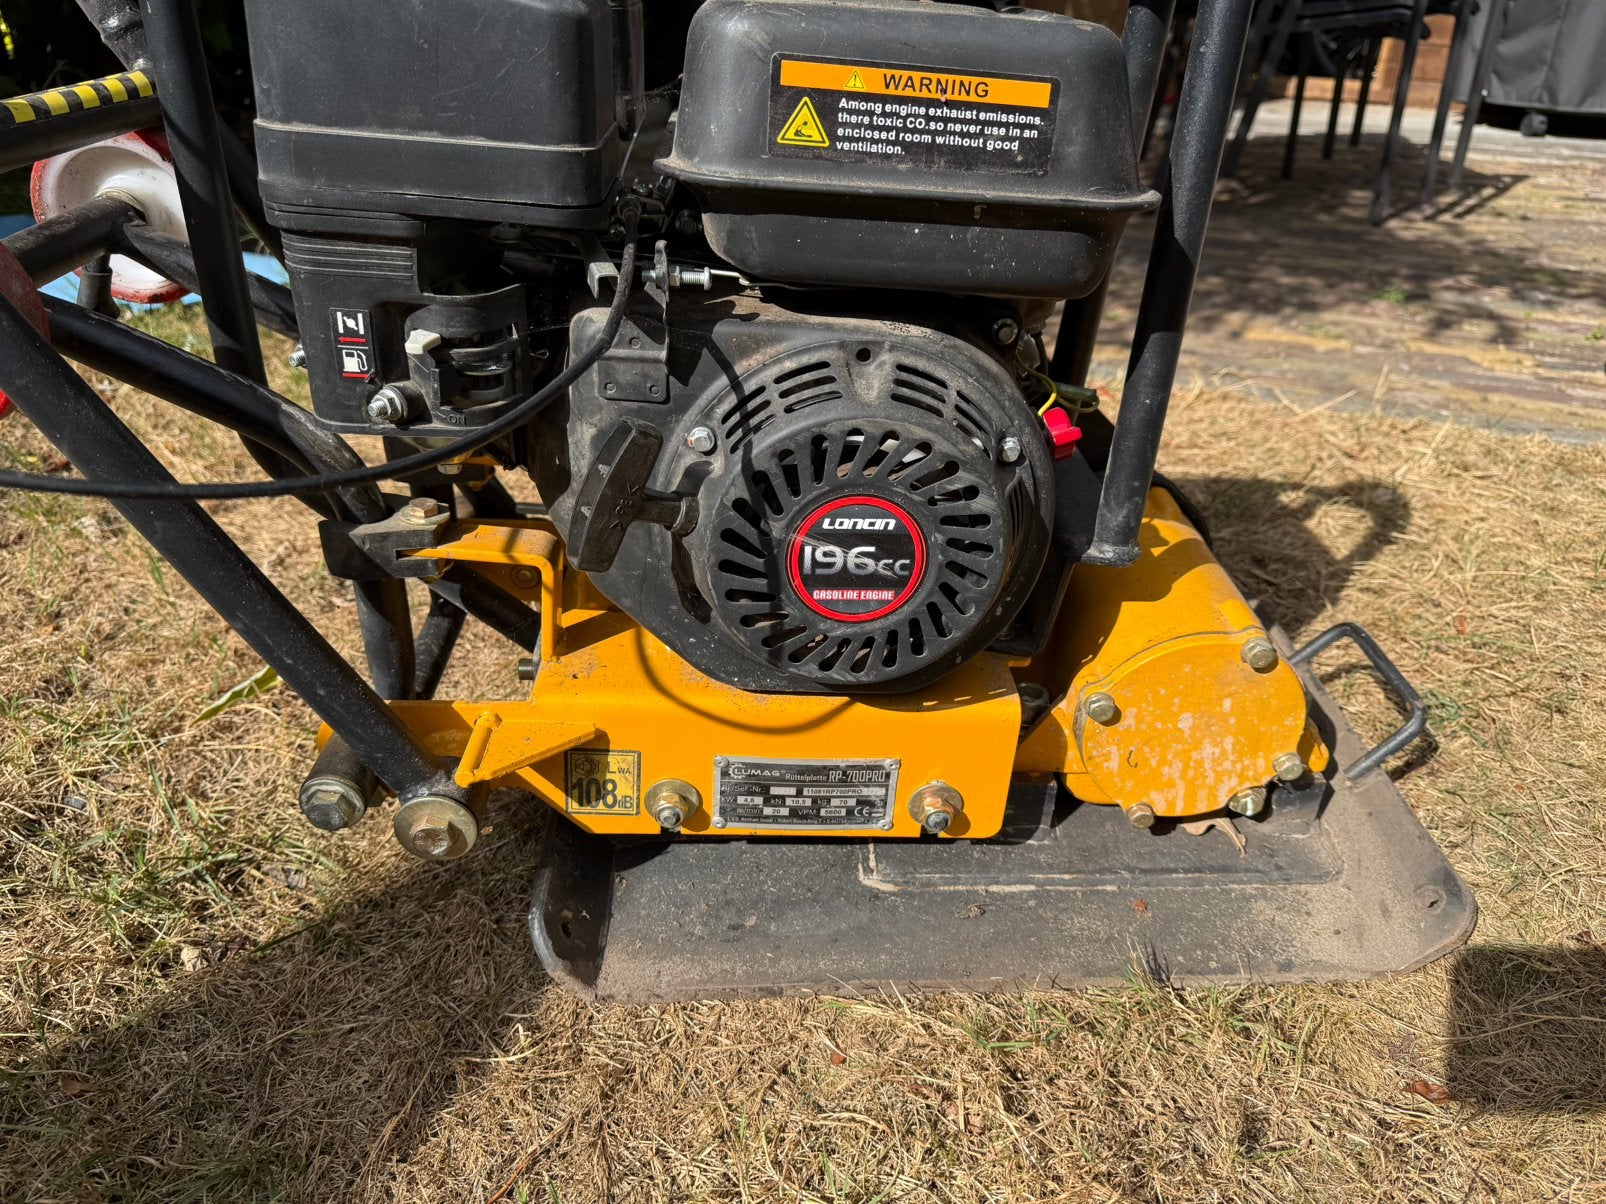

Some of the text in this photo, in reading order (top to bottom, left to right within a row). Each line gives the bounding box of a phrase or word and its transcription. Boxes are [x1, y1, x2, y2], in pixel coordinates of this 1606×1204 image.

[883, 73, 989, 98] WARNING
[838, 97, 1044, 126] Among engine exhaust emissions.
[837, 112, 871, 125] there
[872, 114, 904, 127] toxic
[947, 122, 982, 134] never
[984, 124, 1006, 136] use
[1009, 125, 1020, 137] in
[1023, 128, 1038, 138] an
[835, 138, 906, 155] ventilation.
[836, 125, 1019, 153] enclosed room without good
[447, 413, 468, 425] ON
[813, 589, 894, 601] GASOLINE ENGINE
[734, 766, 780, 777] LUMAG
[785, 770, 886, 783] Rüttelplatte RP-700PRO
[790, 799, 807, 807] 10,5
